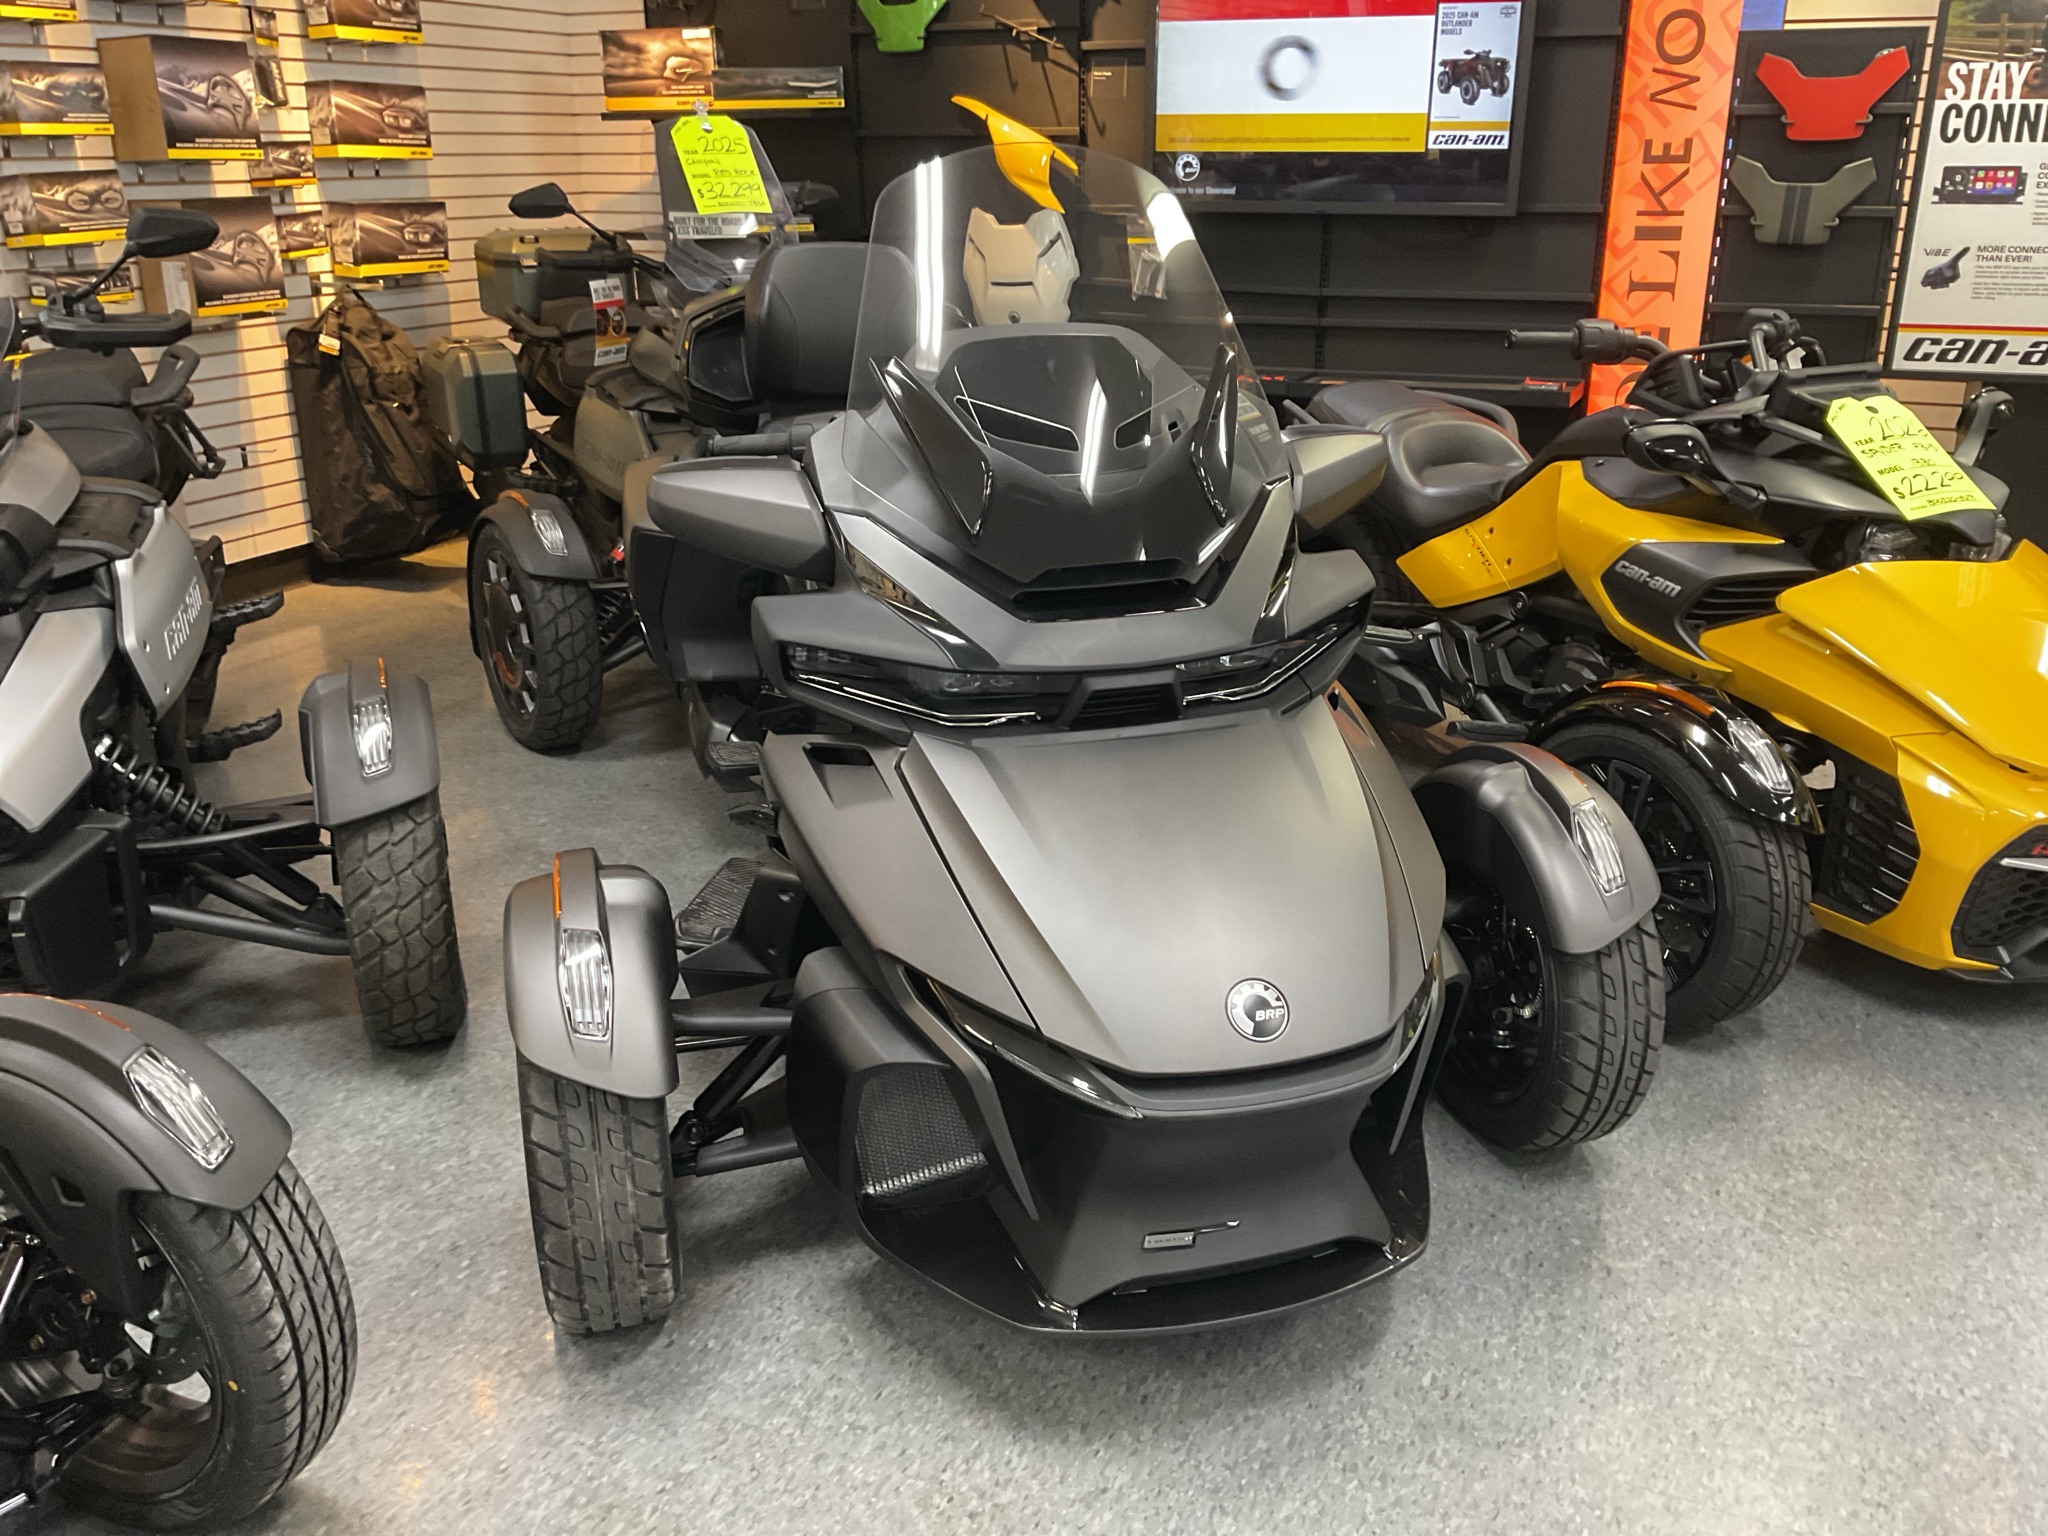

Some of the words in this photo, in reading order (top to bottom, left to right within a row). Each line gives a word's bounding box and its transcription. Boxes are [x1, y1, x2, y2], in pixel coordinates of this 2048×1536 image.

[1442, 11, 1456, 19] 2025
[1440, 27, 1462, 35] MODELS
[1649, 8, 1706, 111] NO
[1944, 61, 2035, 101] STAY
[1939, 103, 2048, 143] CONN
[697, 136, 748, 154] 2025
[1432, 134, 1505, 146] can-am
[1627, 137, 1694, 301] LIKE
[1923, 248, 1952, 257] VIBE
[1976, 245, 2007, 254] MORE
[1975, 254, 2002, 263] THAN
[2004, 255, 2033, 263] EVER!
[1853, 437, 1876, 447] YEAR
[1877, 465, 1905, 476] MODEL
[1615, 560, 1682, 598] can-am
[1255, 1008, 1285, 1022] BRP
